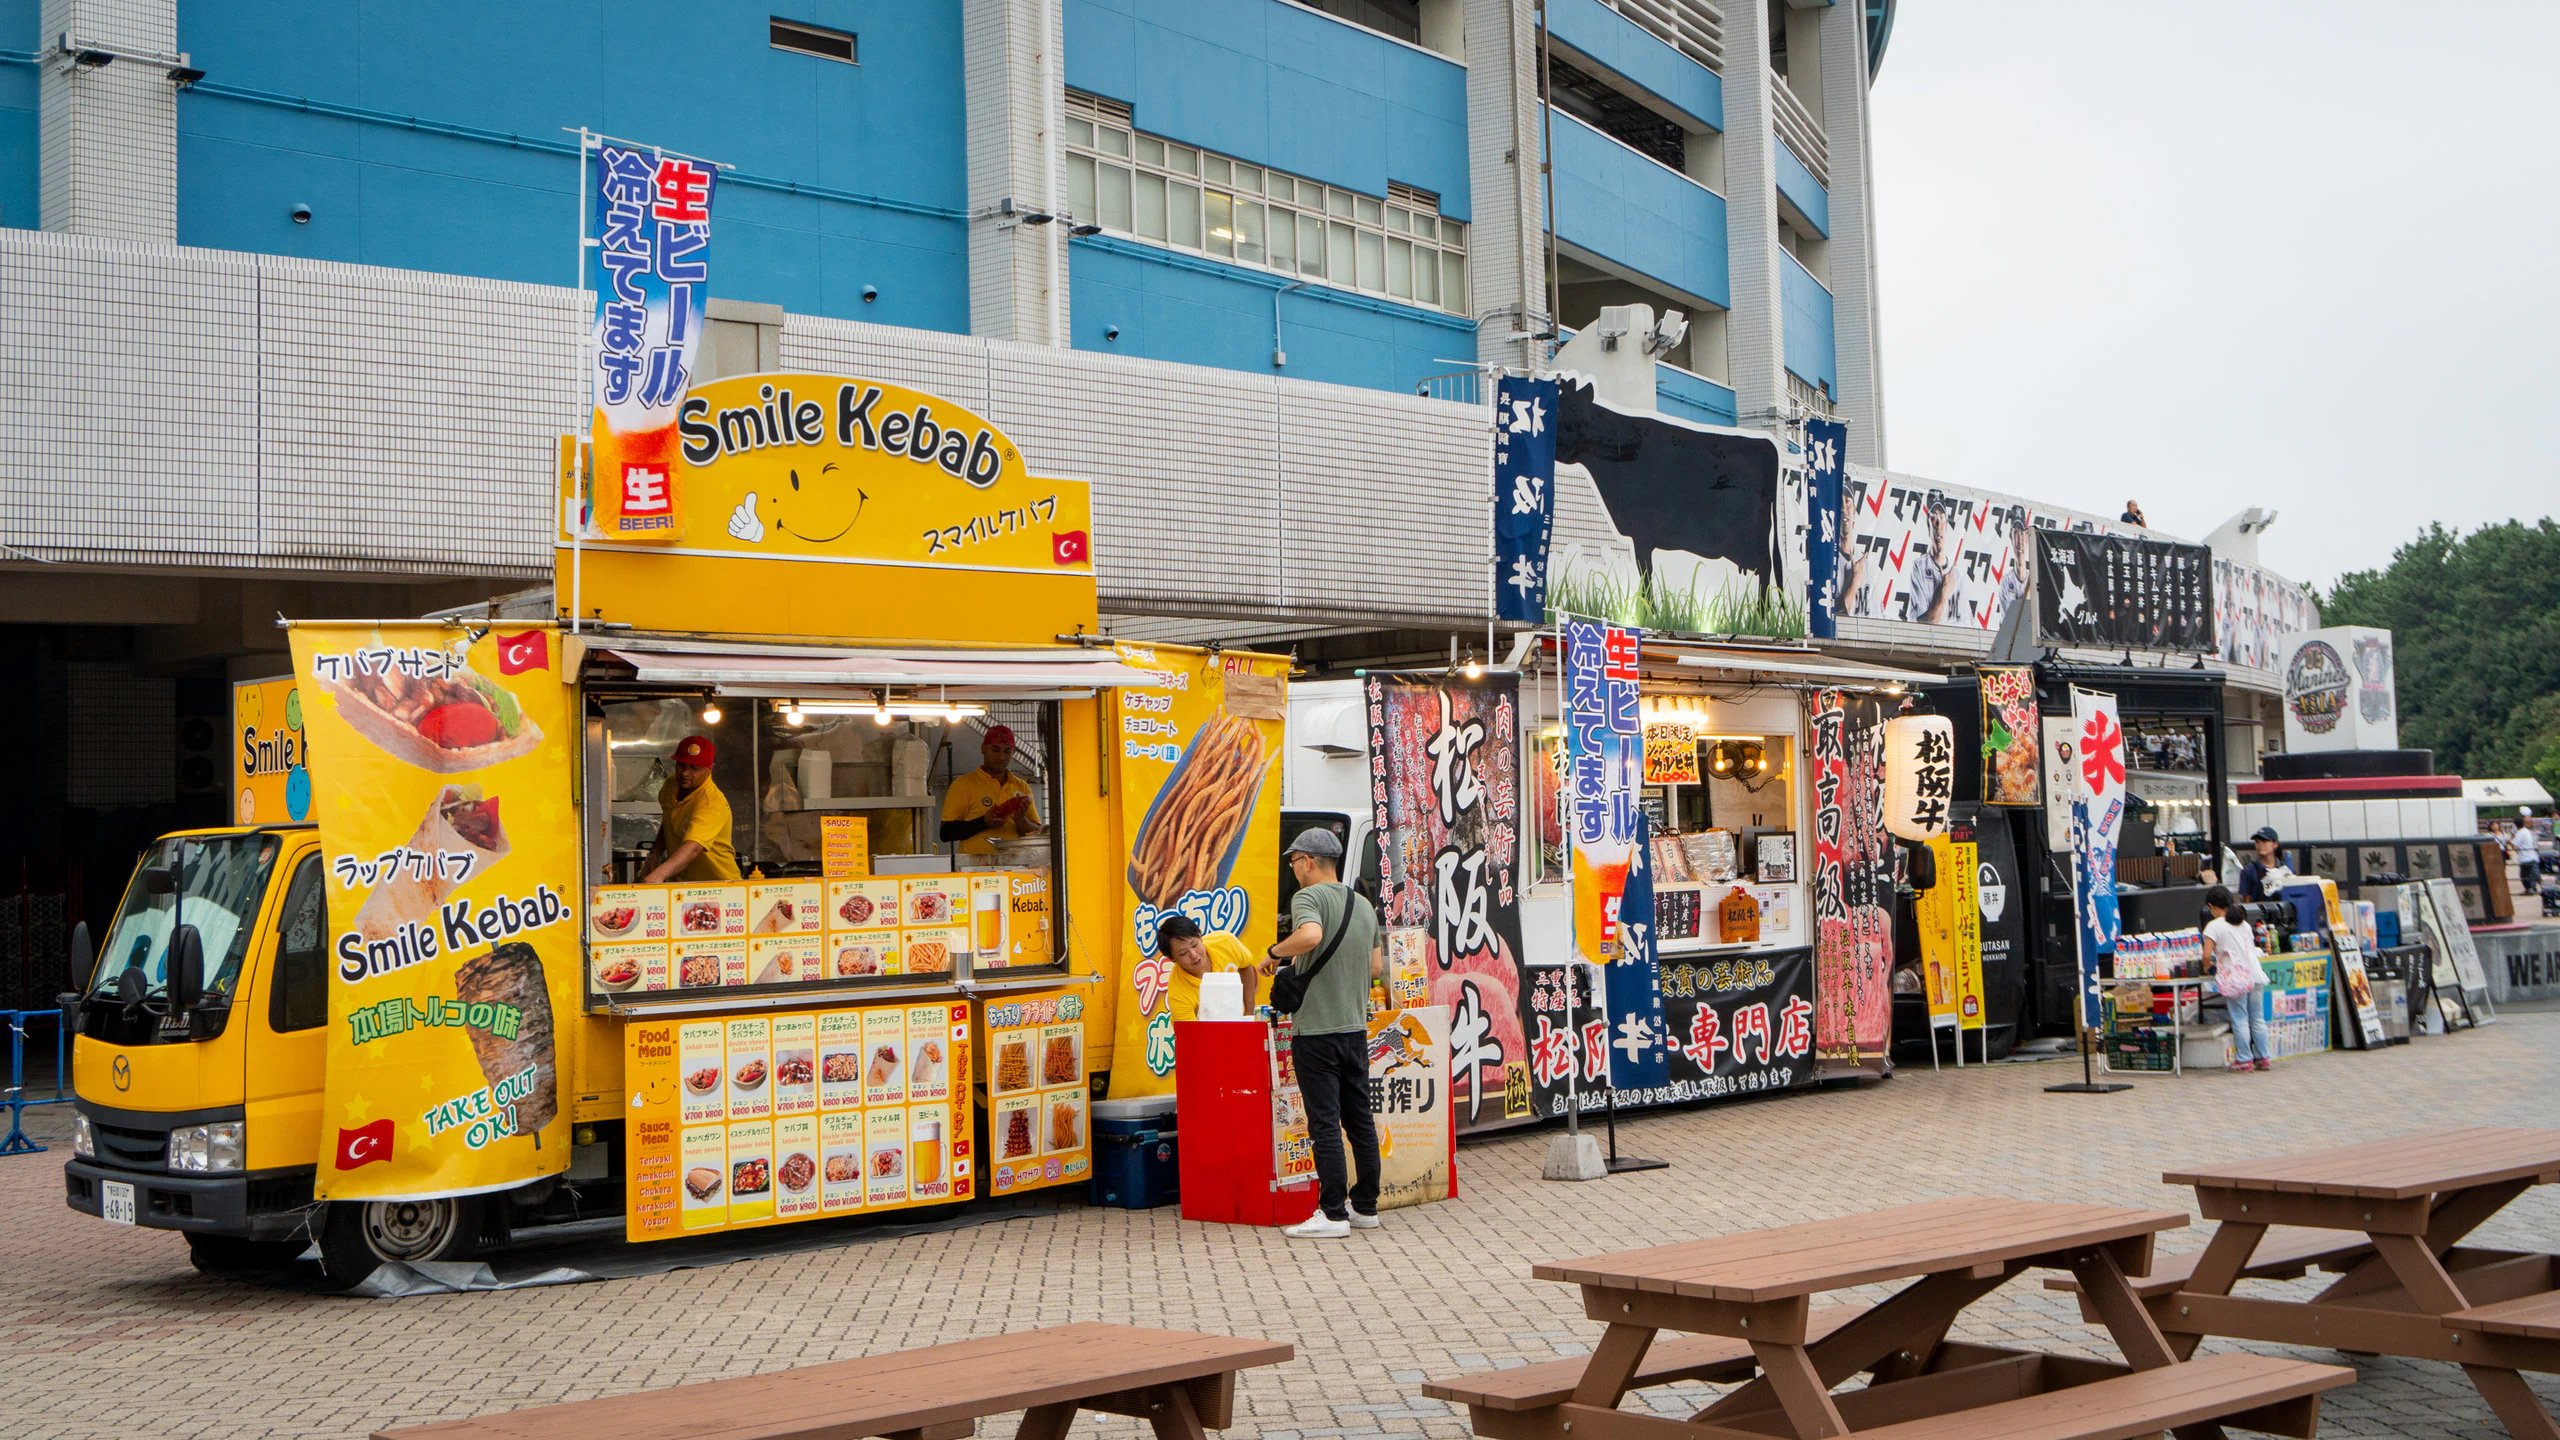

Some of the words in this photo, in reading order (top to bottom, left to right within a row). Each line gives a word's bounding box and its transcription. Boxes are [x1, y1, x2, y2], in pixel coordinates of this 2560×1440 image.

[597, 146, 655, 406] 冷えてます
[637, 157, 711, 409] 生ビール
[679, 384, 825, 466] Smile
[836, 383, 1002, 488] Kebab
[625, 466, 668, 511] 生
[1508, 396, 1547, 600] 松阪牛
[619, 515, 675, 531] BEER!
[923, 494, 1058, 555] スマイルケバブ
[2050, 548, 2076, 566] 北海道
[2077, 610, 2099, 625] グルメ
[316, 650, 463, 679] ケバブサンド
[1225, 656, 1256, 675] ALL
[1983, 667, 2032, 706] 北海道
[1124, 693, 1172, 712] ケチャップ
[1125, 717, 1177, 736] チョコレート
[1570, 621, 1606, 845] 冷えてます
[1603, 627, 1640, 845] 生ビール
[1646, 724, 1693, 742] 本日限定
[244, 726, 294, 775] Smile
[2079, 709, 2126, 796] 氷
[1911, 729, 1951, 833] 松阪牛
[1493, 693, 1517, 907] 肉の芸術品
[1813, 688, 1847, 921] 最高級
[335, 850, 474, 887] ラップケバブ
[1011, 876, 1047, 896] Smile
[880, 901, 898, 910] ¥800
[1426, 688, 1503, 1124] 松阪牛
[1681, 894, 1691, 935] 特産品
[1728, 906, 1756, 922] 松阪牛
[1134, 886, 1249, 958] もちり
[1954, 846, 1970, 994] アサヒスーパードライ
[1404, 931, 1416, 951] 新
[338, 921, 437, 982] Smile
[802, 957, 820, 965] ¥800
[647, 966, 666, 975] ¥800
[2506, 954, 2541, 987] WE
[1406, 989, 1423, 999] 生ビール
[349, 995, 522, 1045] 本場トルコの味
[822, 1015, 855, 1024] ダブルチーズ
[867, 1015, 900, 1025] ラップケバブ
[911, 1009, 944, 1018] ダブルチーズ
[1650, 962, 1664, 1065] 三重県松阪市
[684, 1028, 720, 1039] ケバブサンド
[731, 1021, 765, 1030] ダブルチーズ
[776, 1022, 812, 1031] おつまみケバブ
[821, 1022, 857, 1032] おつまみケバブ
[639, 1028, 669, 1044] Food
[1007, 1032, 1023, 1041] チーズ
[638, 1044, 672, 1059] Menu
[424, 1088, 490, 1137] TAKE
[494, 1063, 538, 1110] OUT
[911, 1090, 929, 1098] ¥800
[929, 1088, 947, 1096] ¥900
[955, 1083, 967, 1110] OUT
[732, 1106, 750, 1115] ¥800
[752, 1105, 769, 1114] ¥900
[1005, 1099, 1029, 1109] ケチャップ
[685, 1111, 703, 1120] ¥700
[704, 1109, 723, 1118] ¥800
[824, 1115, 858, 1125] ダブルチーズ
[465, 1107, 519, 1150] OK!
[640, 1122, 670, 1134] Sauce
[642, 1134, 670, 1145] Menu
[1289, 1149, 1311, 1161] 生ビール
[1285, 1158, 1314, 1175] 700
[923, 1183, 948, 1195] ¥700
[110, 1199, 134, 1222] 68-19
